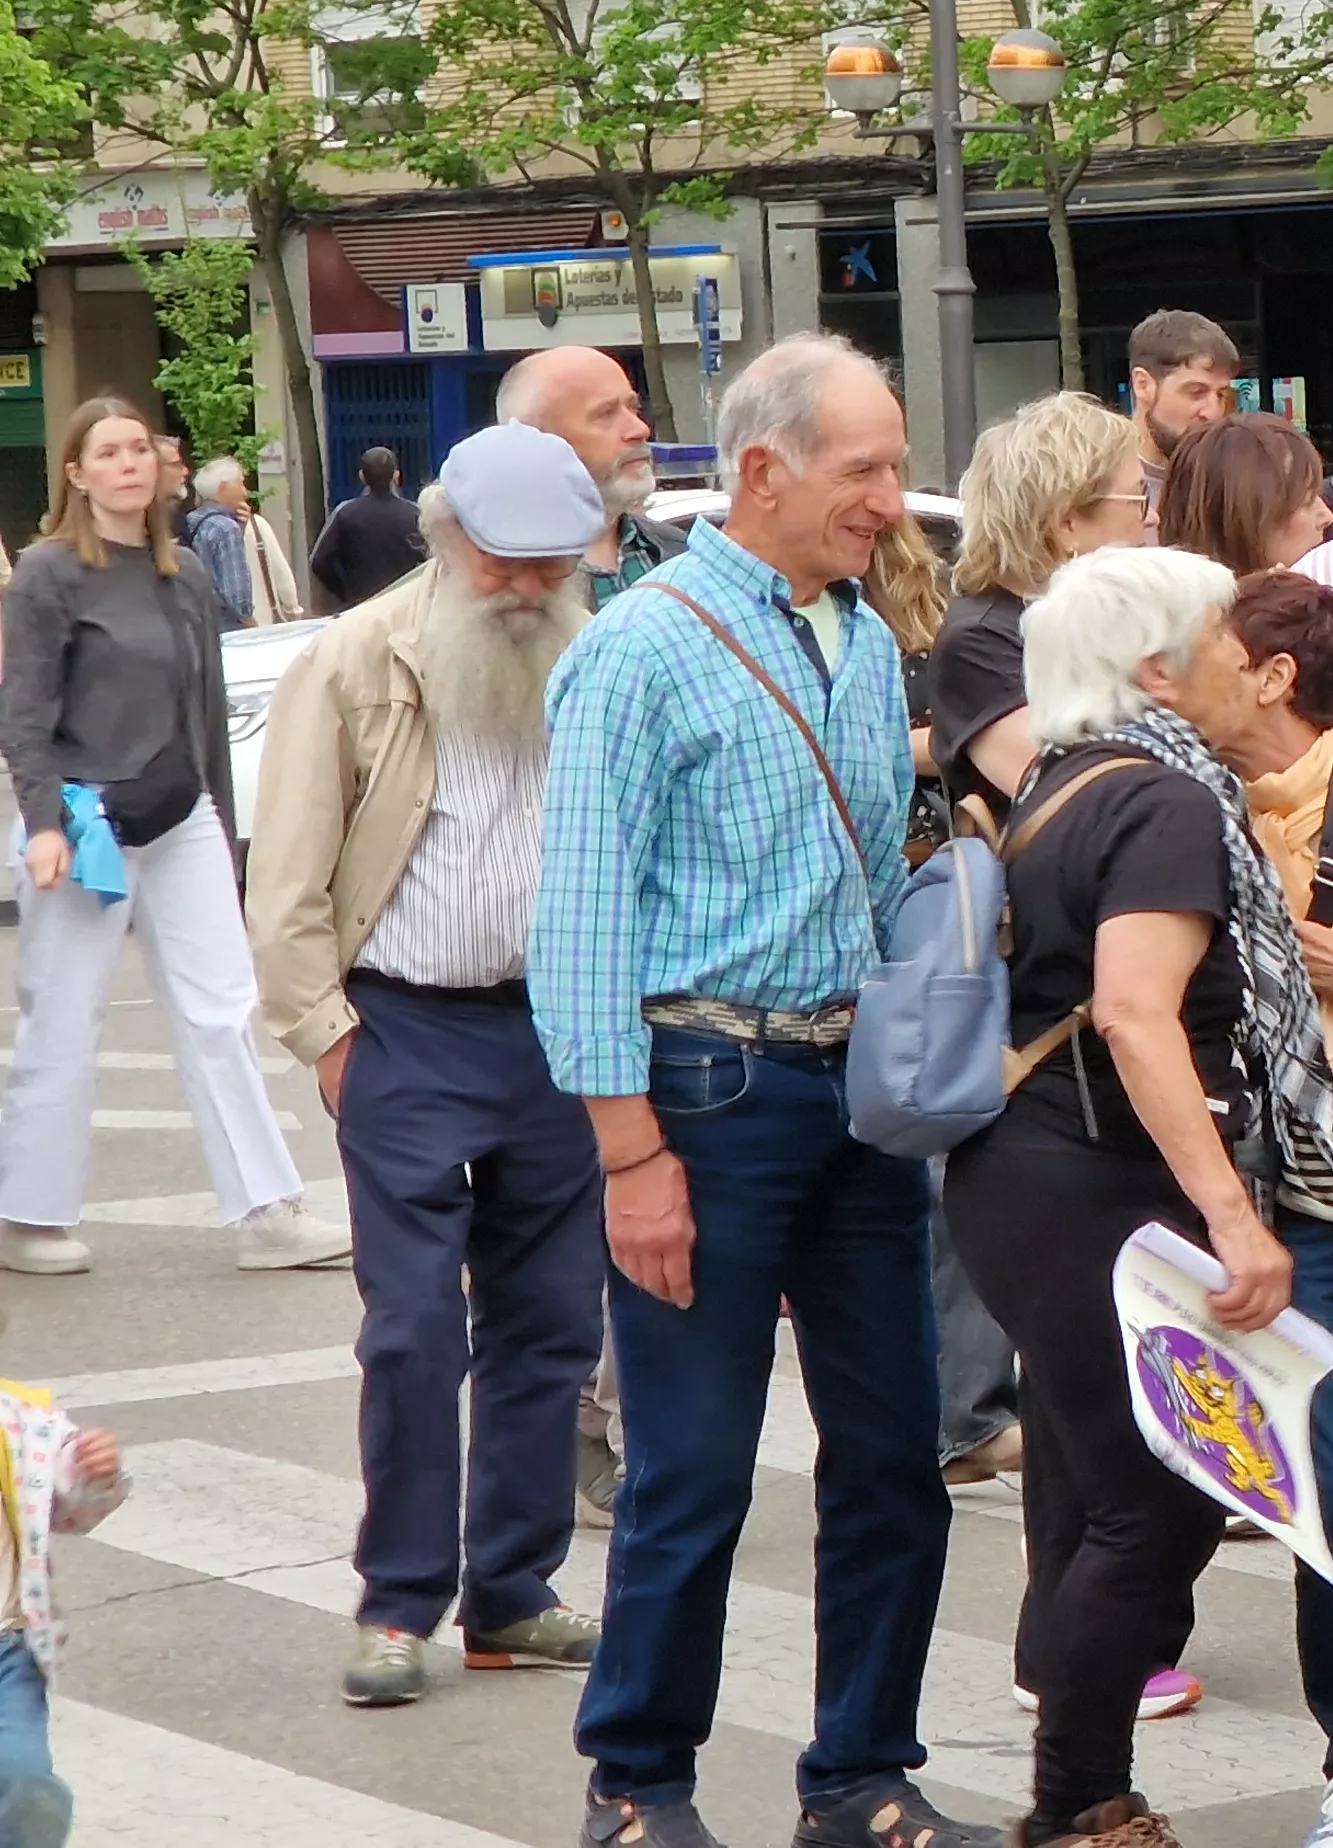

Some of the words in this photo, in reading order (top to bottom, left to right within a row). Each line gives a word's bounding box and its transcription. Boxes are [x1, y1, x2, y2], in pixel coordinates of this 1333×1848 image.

[614, 269, 621, 287] y
[566, 291, 618, 312] Apuestas
[622, 287, 641, 305] de
[0, 361, 24, 379] CE
